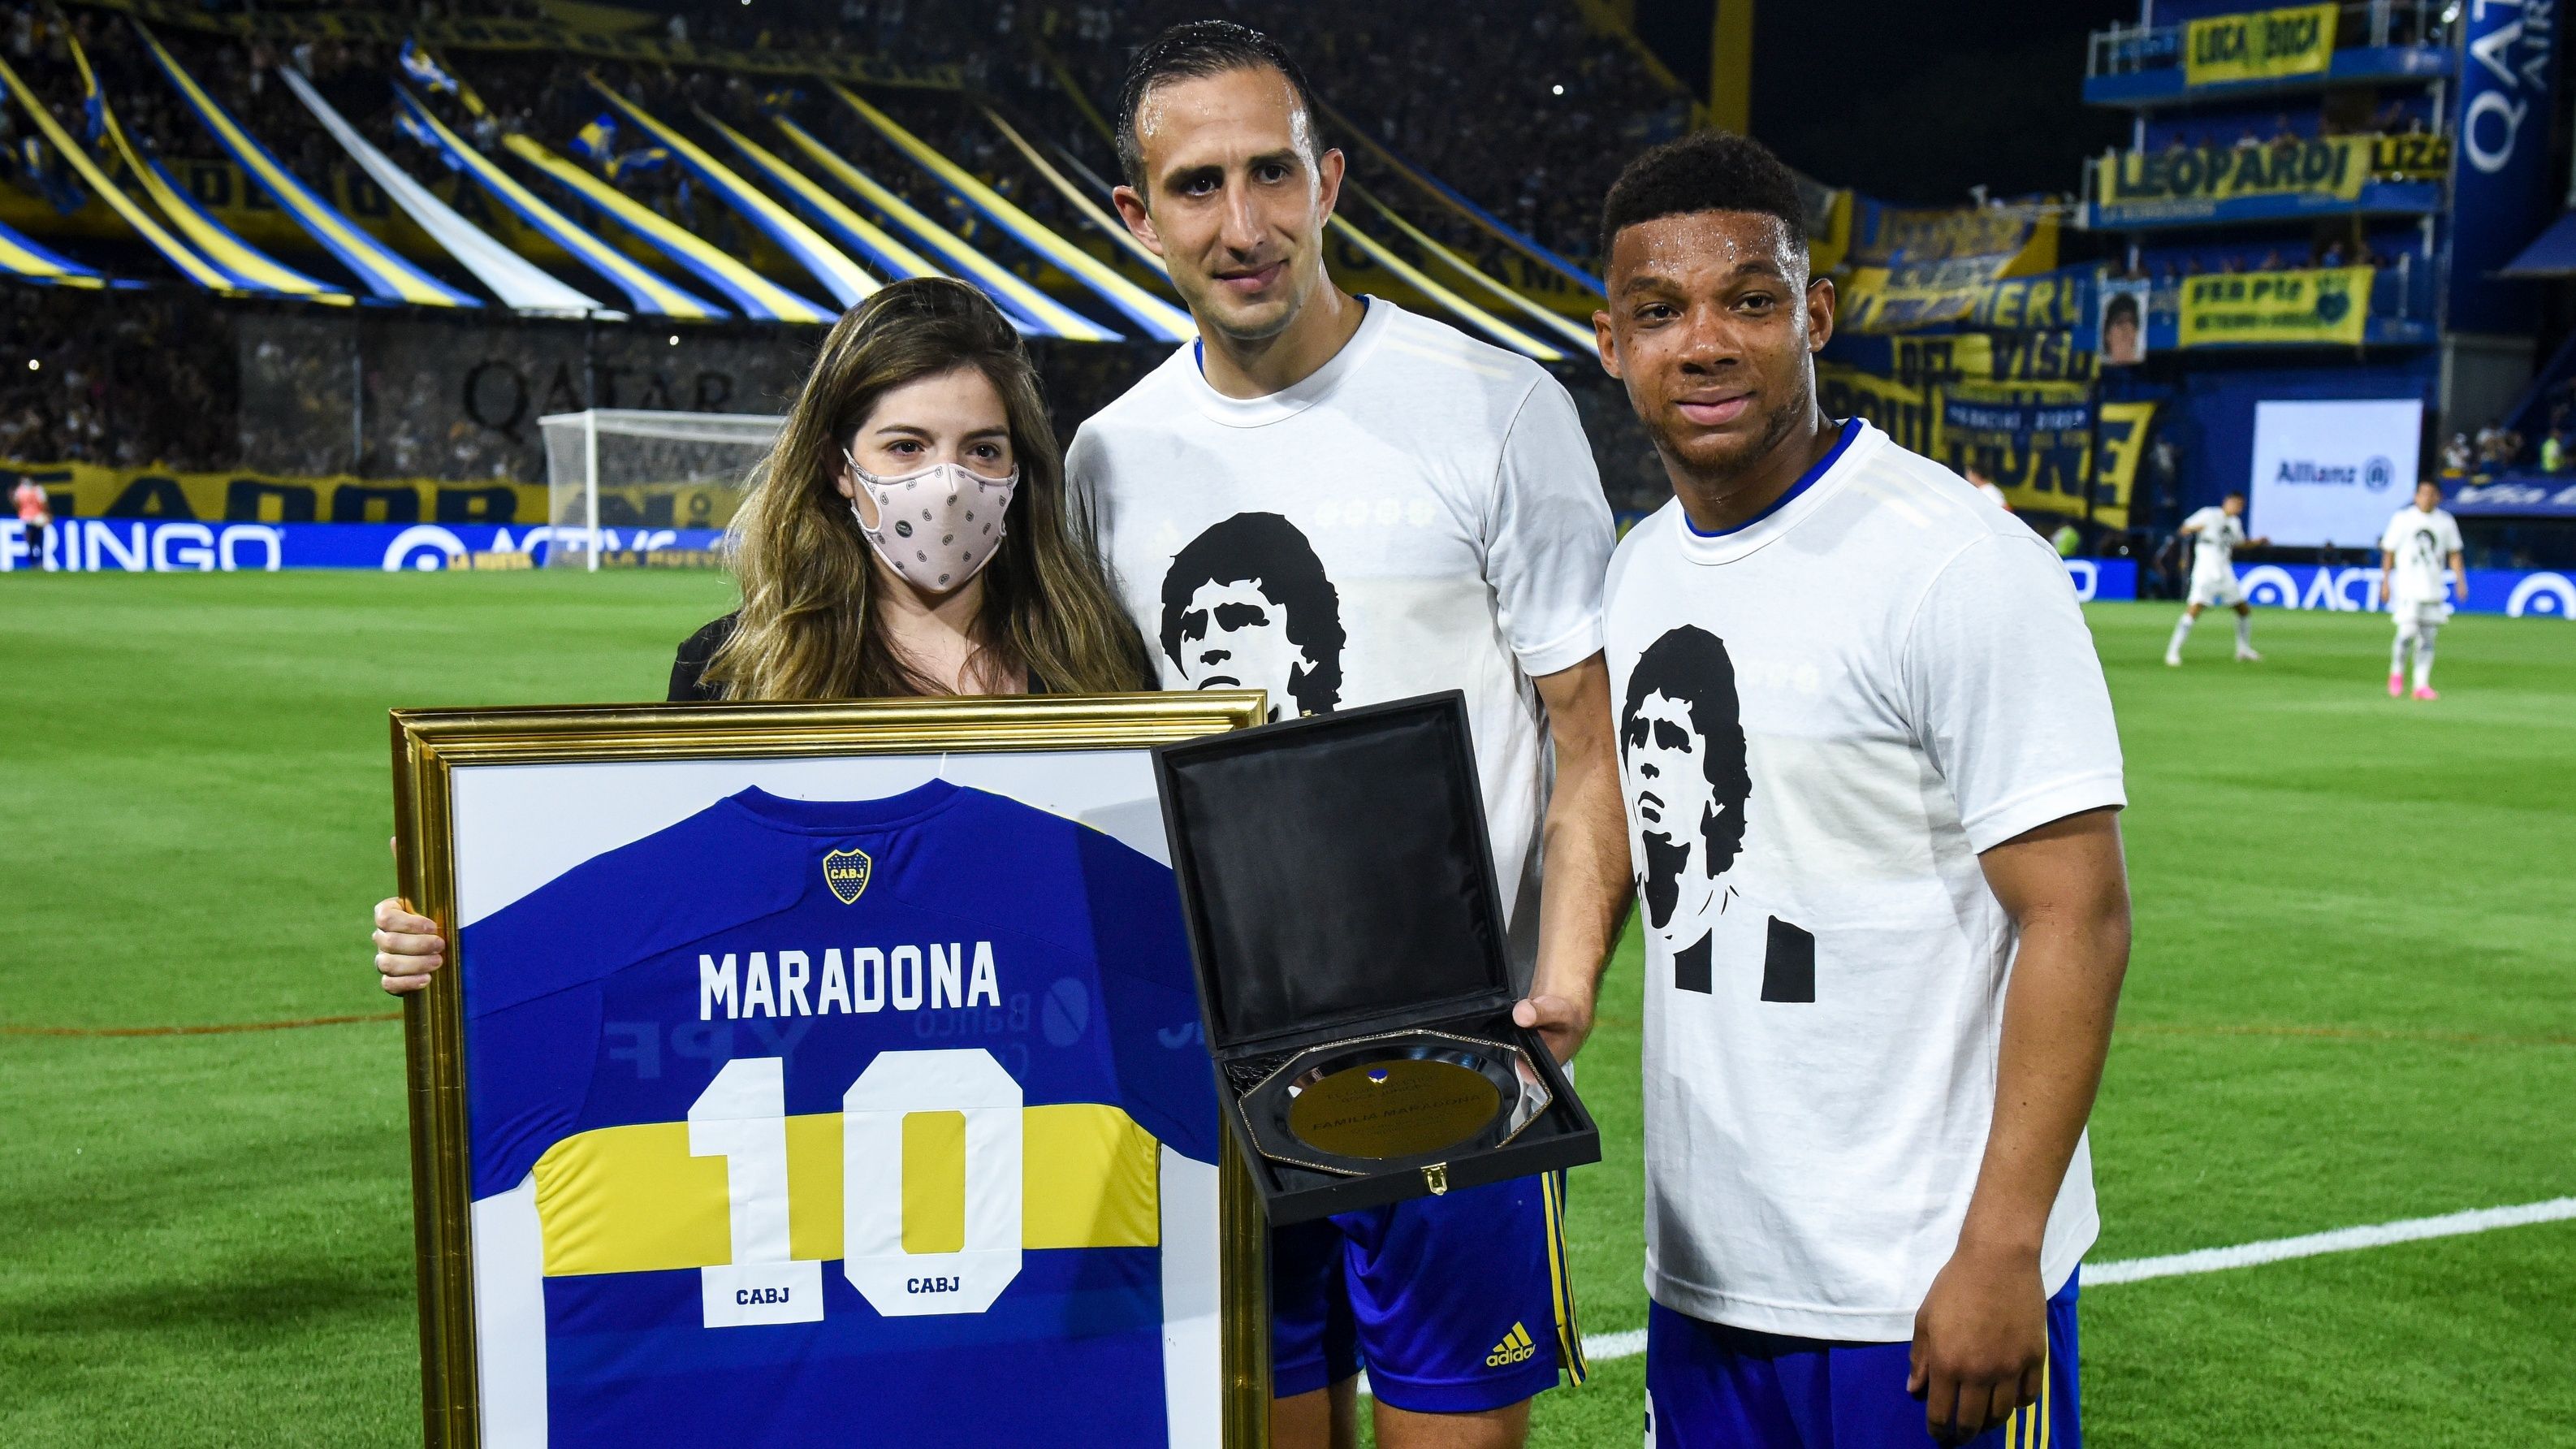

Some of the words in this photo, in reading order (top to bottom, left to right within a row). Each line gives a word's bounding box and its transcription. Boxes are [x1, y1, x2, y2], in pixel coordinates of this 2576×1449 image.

[2115, 138, 2351, 197] LEOPARDI
[2278, 459, 2356, 484] Allianz
[831, 867, 865, 880] CABJ
[699, 941, 1001, 1021] MARADONA
[1312, 1114, 1379, 1131] FAMILIA
[1383, 1095, 1481, 1118] MARADONA
[687, 1048, 1023, 1330] 10
[736, 1287, 790, 1305] CABJ
[906, 1276, 961, 1294] CABJ
[1485, 1343, 1537, 1368] adidas
